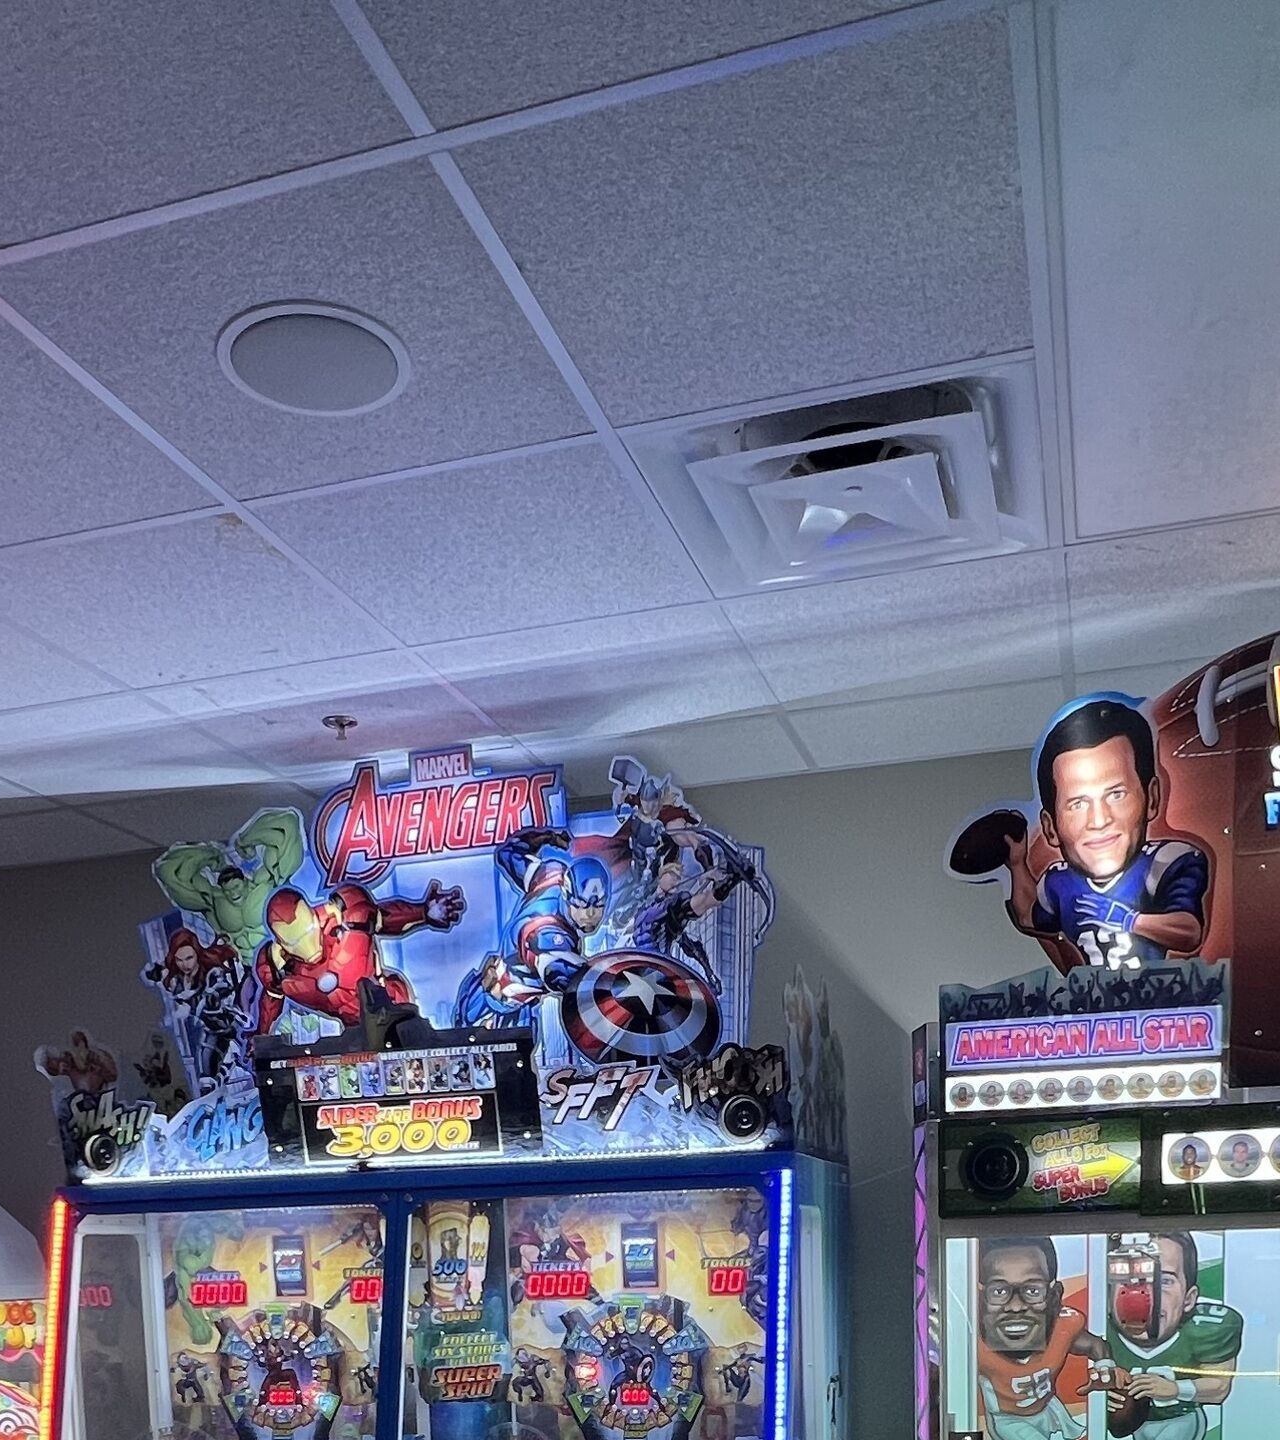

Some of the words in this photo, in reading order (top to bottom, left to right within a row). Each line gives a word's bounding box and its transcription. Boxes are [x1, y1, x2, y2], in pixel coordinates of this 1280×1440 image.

[416, 753, 469, 782] MARVEL
[318, 766, 556, 886] AVENGERS
[956, 1024, 1088, 1061] AMERICAN
[1092, 1017, 1138, 1054] ALL
[1143, 1015, 1210, 1049] STAR
[540, 1067, 654, 1130] SFFT
[317, 1104, 378, 1128] SUPER
[410, 1097, 483, 1120] BONUS
[1032, 1123, 1100, 1152] COLLECT
[1032, 1165, 1079, 1190] SUPER
[1058, 1177, 1109, 1203] BONUS
[433, 1260, 467, 1275] 500
[531, 1262, 581, 1272] TICKETS
[703, 1258, 751, 1268] TOKENS
[527, 1274, 587, 1296] 0000
[711, 1270, 744, 1292] 00
[433, 1365, 502, 1384] SUPER
[442, 1381, 495, 1399] SPIN
